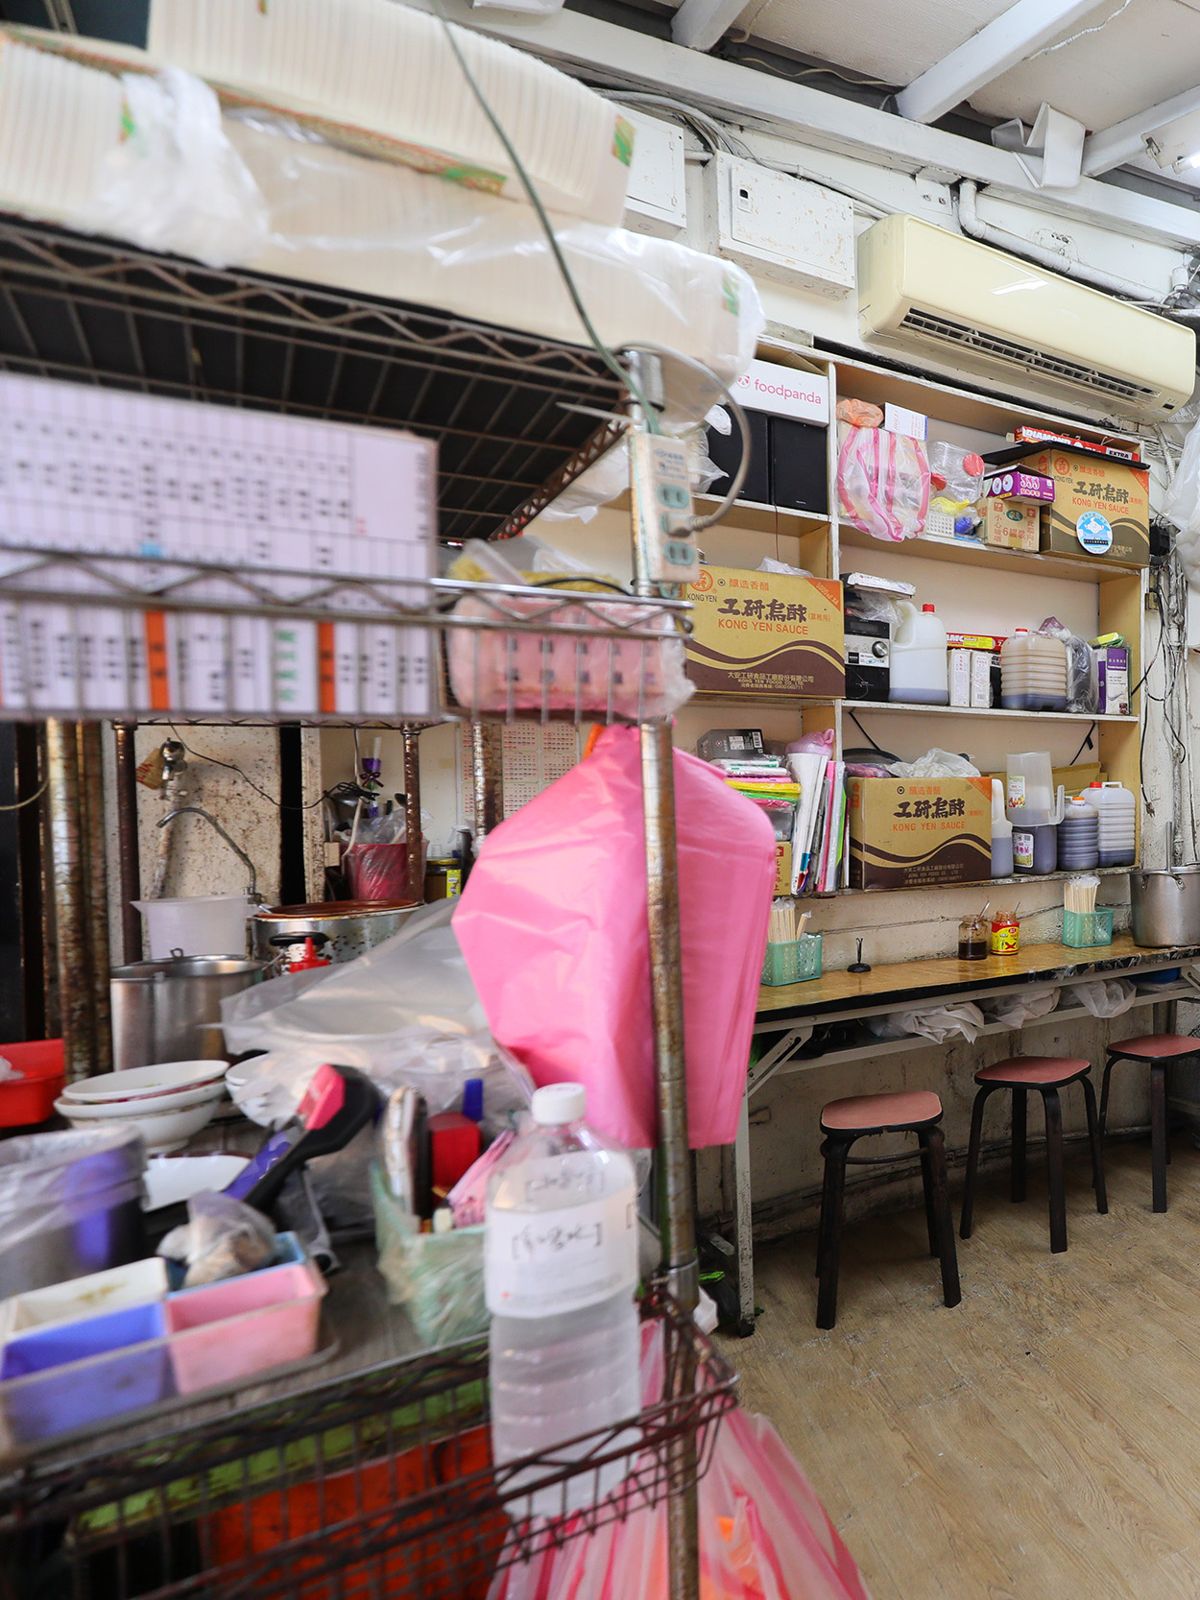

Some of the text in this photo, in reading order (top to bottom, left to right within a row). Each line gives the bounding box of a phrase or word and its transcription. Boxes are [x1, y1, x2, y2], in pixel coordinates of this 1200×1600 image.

[754, 379, 822, 405] foodpanda
[1108, 450, 1129, 459] EXTRA
[1072, 497, 1129, 515] KONG YEN SAUCE
[718, 619, 808, 635] KONG YEN SAUCE
[892, 820, 966, 832] KONG YEN SAUCE
